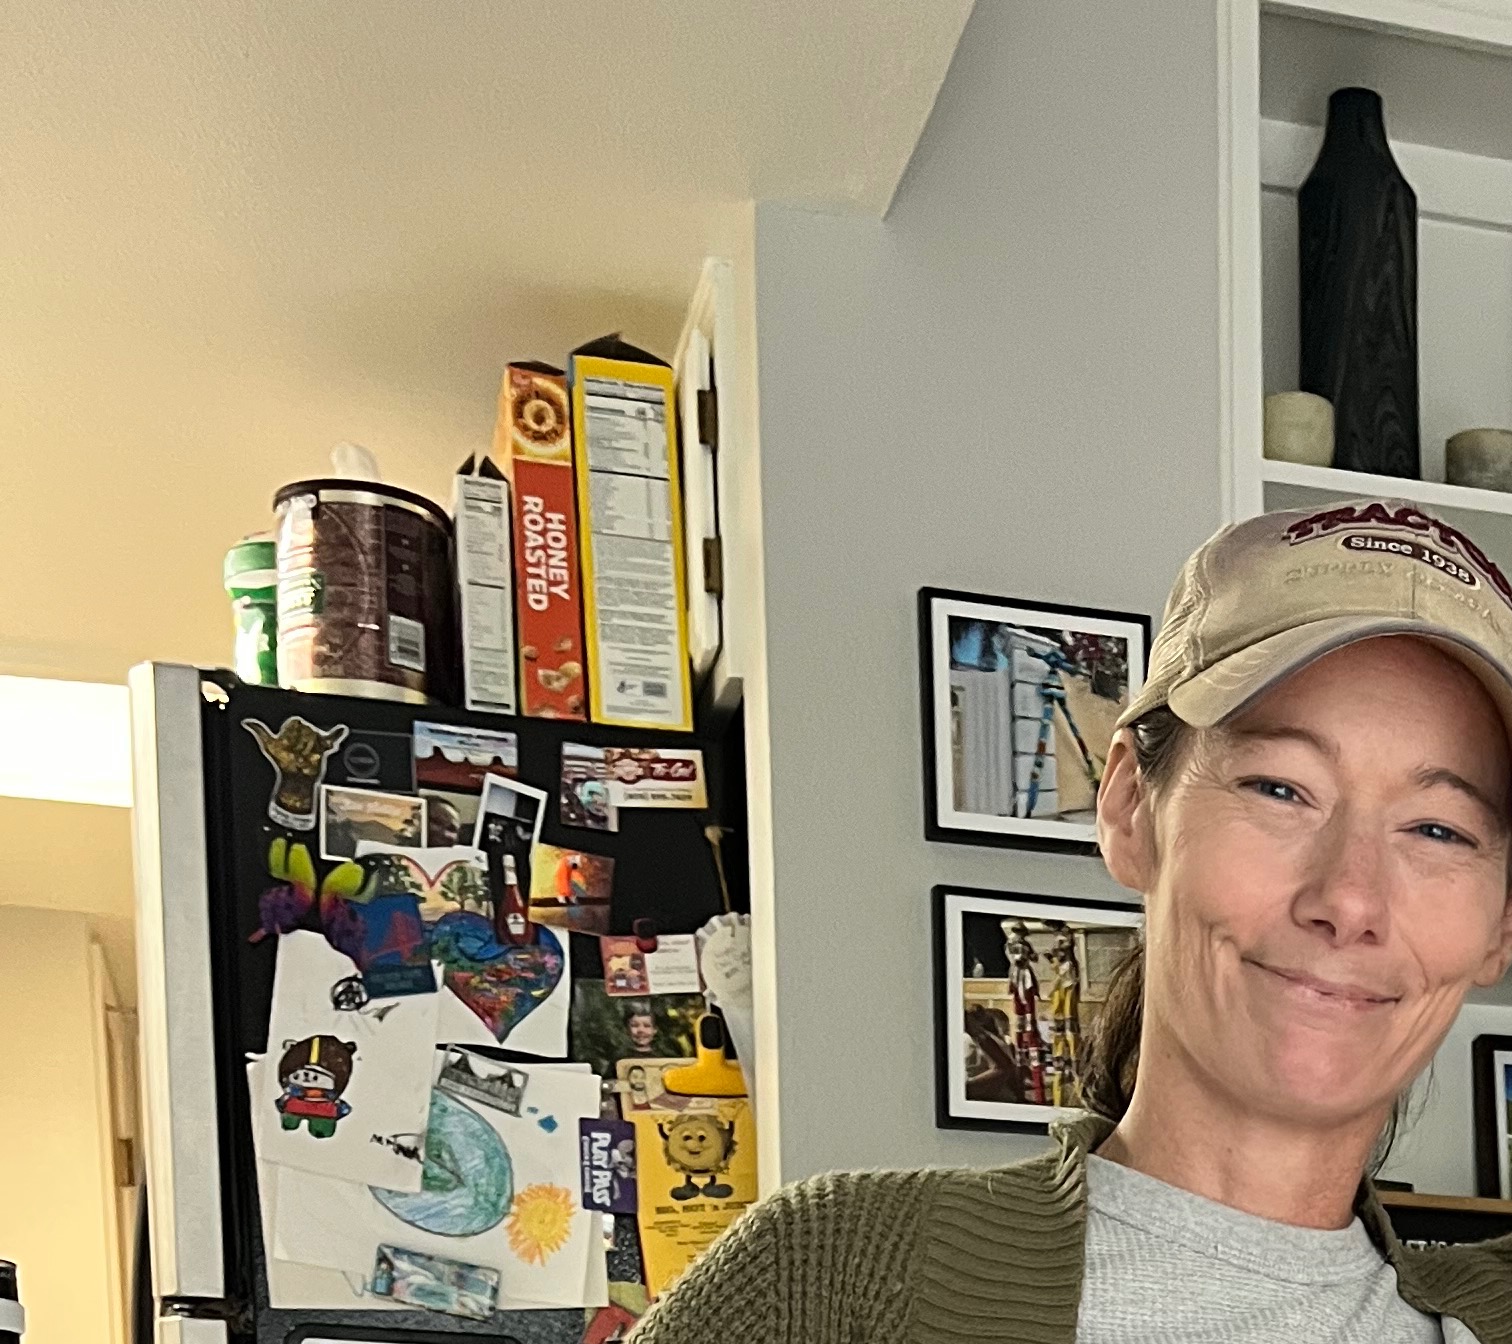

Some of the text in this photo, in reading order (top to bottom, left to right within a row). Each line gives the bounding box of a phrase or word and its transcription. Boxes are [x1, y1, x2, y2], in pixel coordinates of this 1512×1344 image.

[522, 495, 549, 611] ROASTED
[544, 512, 571, 600] HONEY
[1350, 537, 1471, 583] Since 1938
